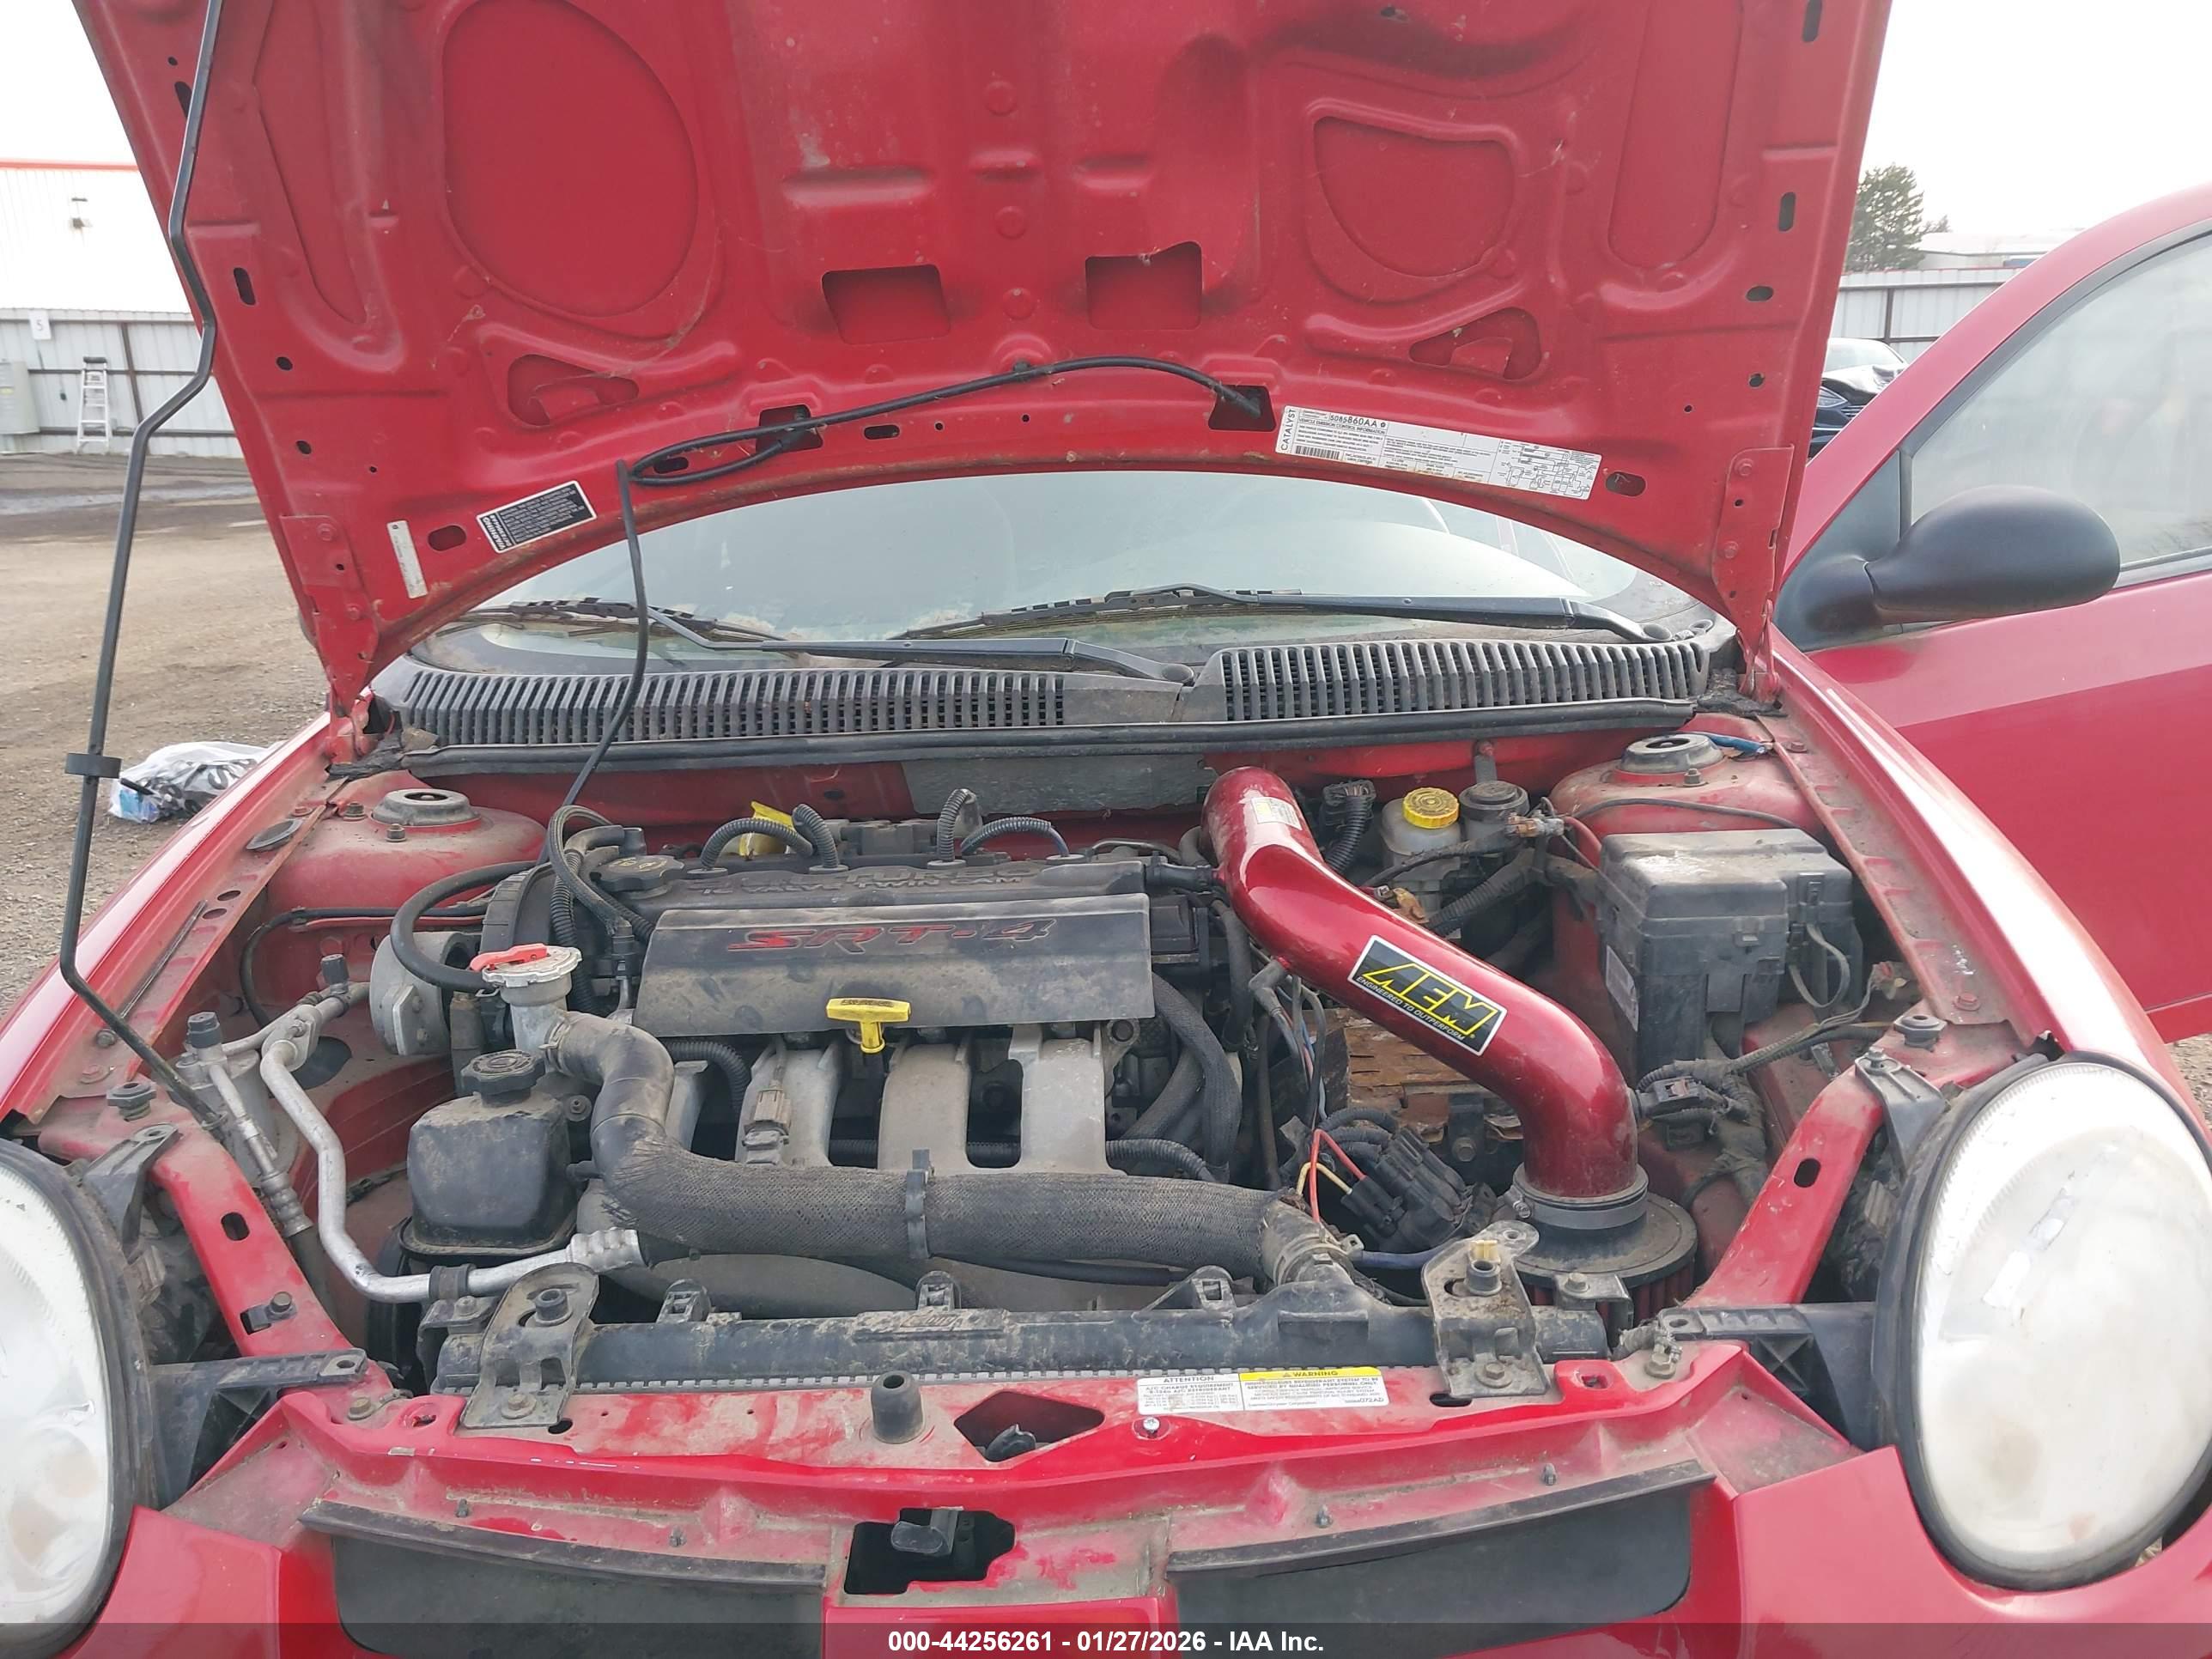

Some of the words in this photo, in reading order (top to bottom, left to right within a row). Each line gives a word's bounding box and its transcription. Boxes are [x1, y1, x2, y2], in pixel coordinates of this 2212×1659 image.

[1280, 409, 1297, 451] CATALYST
[483, 516, 506, 550] WARNING
[845, 865, 1040, 883] TURBO
[854, 878, 940, 890] TWIN
[950, 877, 1023, 886] CAM
[727, 918, 1057, 955] SRT-4
[1355, 975, 1403, 1007] ENGINEERED
[1402, 1001, 1415, 1012] TO
[1413, 1008, 1466, 1041] OUTPERFORM
[1362, 963, 1498, 1036] AEM
